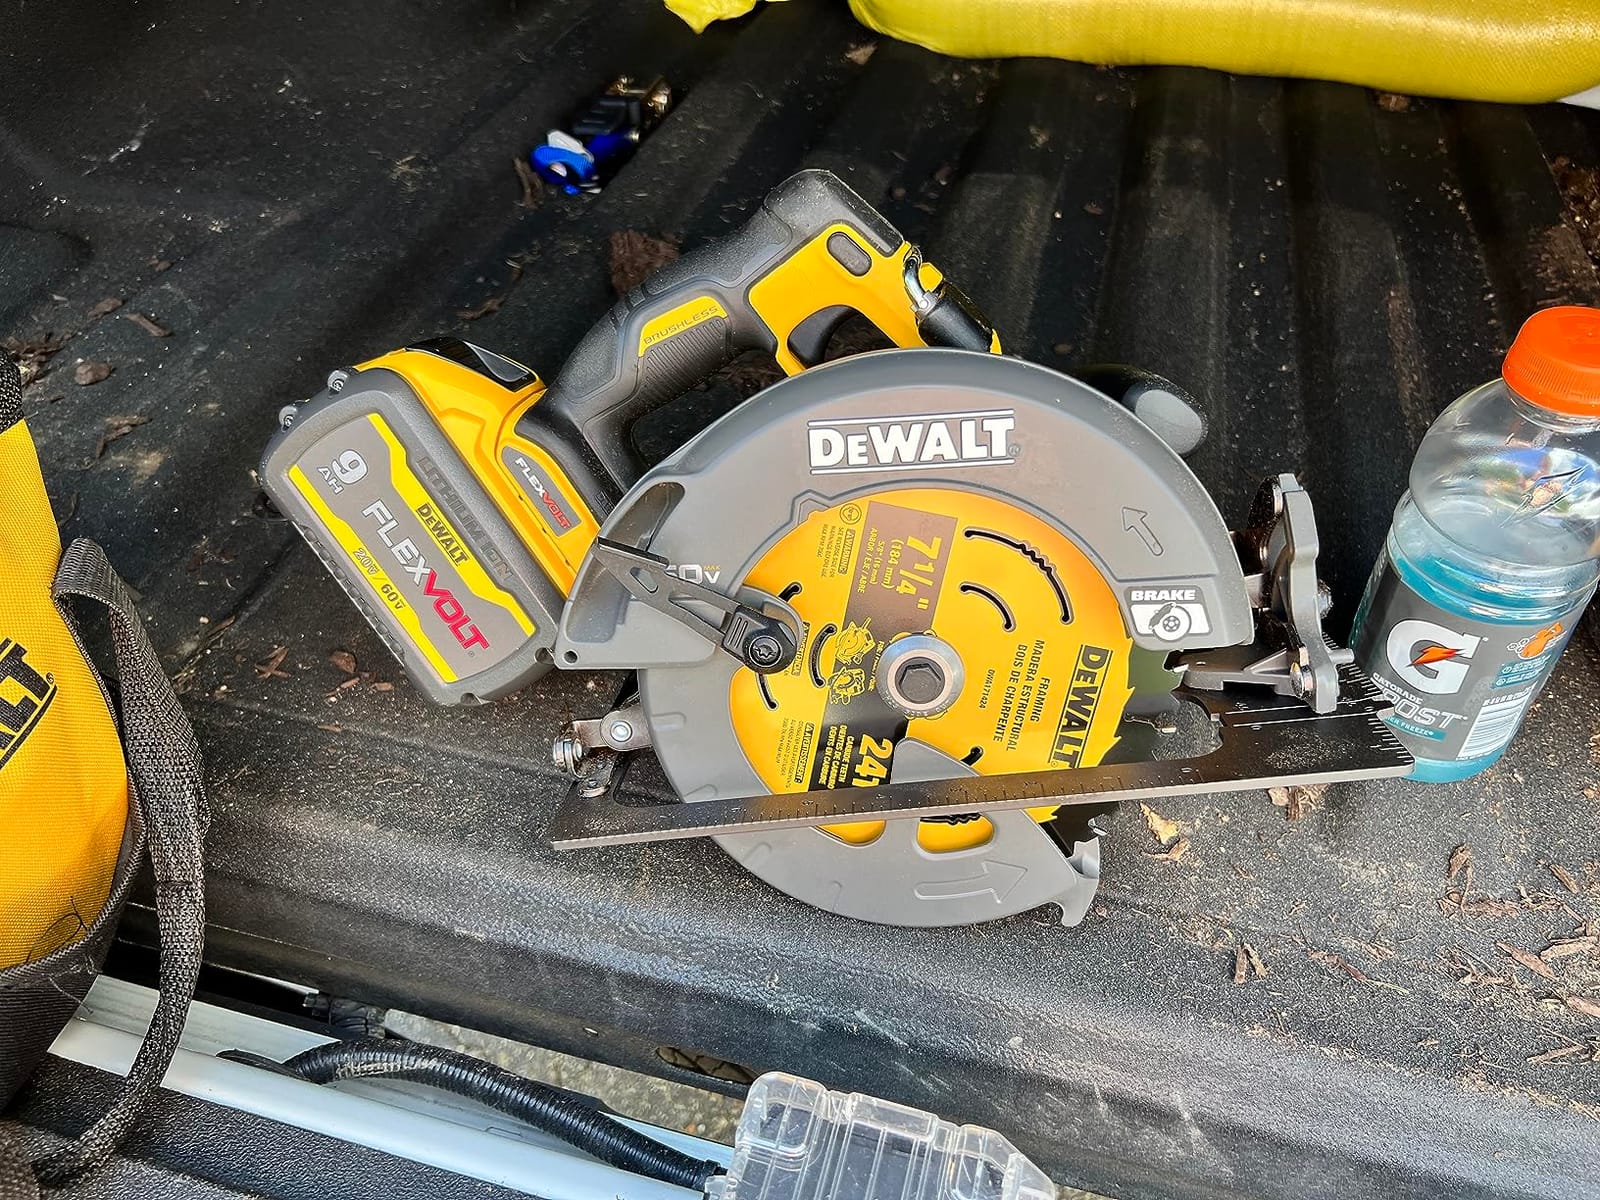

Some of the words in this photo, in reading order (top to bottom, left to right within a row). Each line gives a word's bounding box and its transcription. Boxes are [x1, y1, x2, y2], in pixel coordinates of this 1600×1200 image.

[644, 305, 718, 344] BRUSHLESS
[317, 465, 345, 495] AH
[331, 450, 369, 484] 9
[514, 457, 572, 530] FLEXVOLT
[416, 456, 483, 549] LITHIUM
[480, 540, 514, 581] ION
[361, 500, 491, 651] FLEXVOLT
[1130, 589, 1196, 601] BRAKE
[1008, 669, 1020, 683] DE
[1012, 643, 1027, 668] BOIS
[1024, 639, 1044, 682] MADERA
[1386, 619, 1482, 695] G
[1029, 676, 1050, 723] FRAMING
[1372, 672, 1424, 705] GATORADE
[992, 685, 1016, 743] CHARPENTE
[1005, 684, 1032, 753] ESTRUCTURAL
